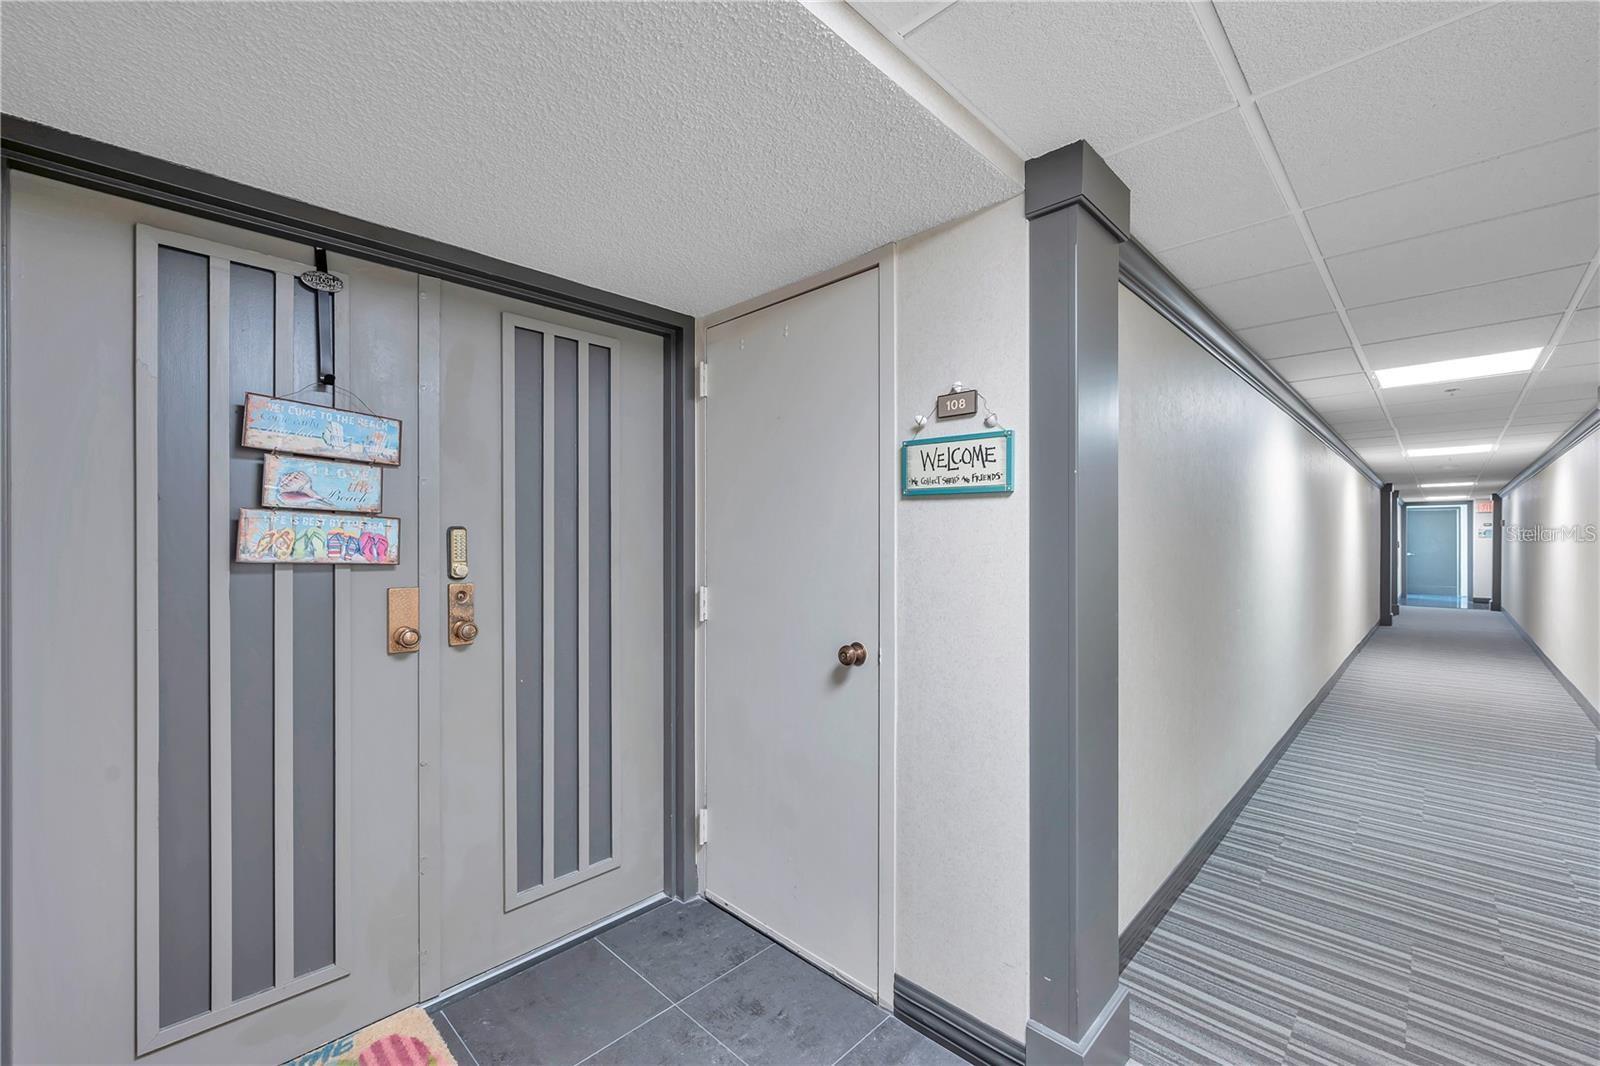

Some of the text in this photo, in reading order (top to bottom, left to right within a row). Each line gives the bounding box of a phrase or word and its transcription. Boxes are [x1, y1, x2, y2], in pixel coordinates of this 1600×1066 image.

[303, 273, 343, 289] WELCOME
[945, 398, 966, 411] 108
[320, 411, 333, 421] TO
[336, 414, 355, 425] THE
[920, 444, 997, 472] WELCOME
